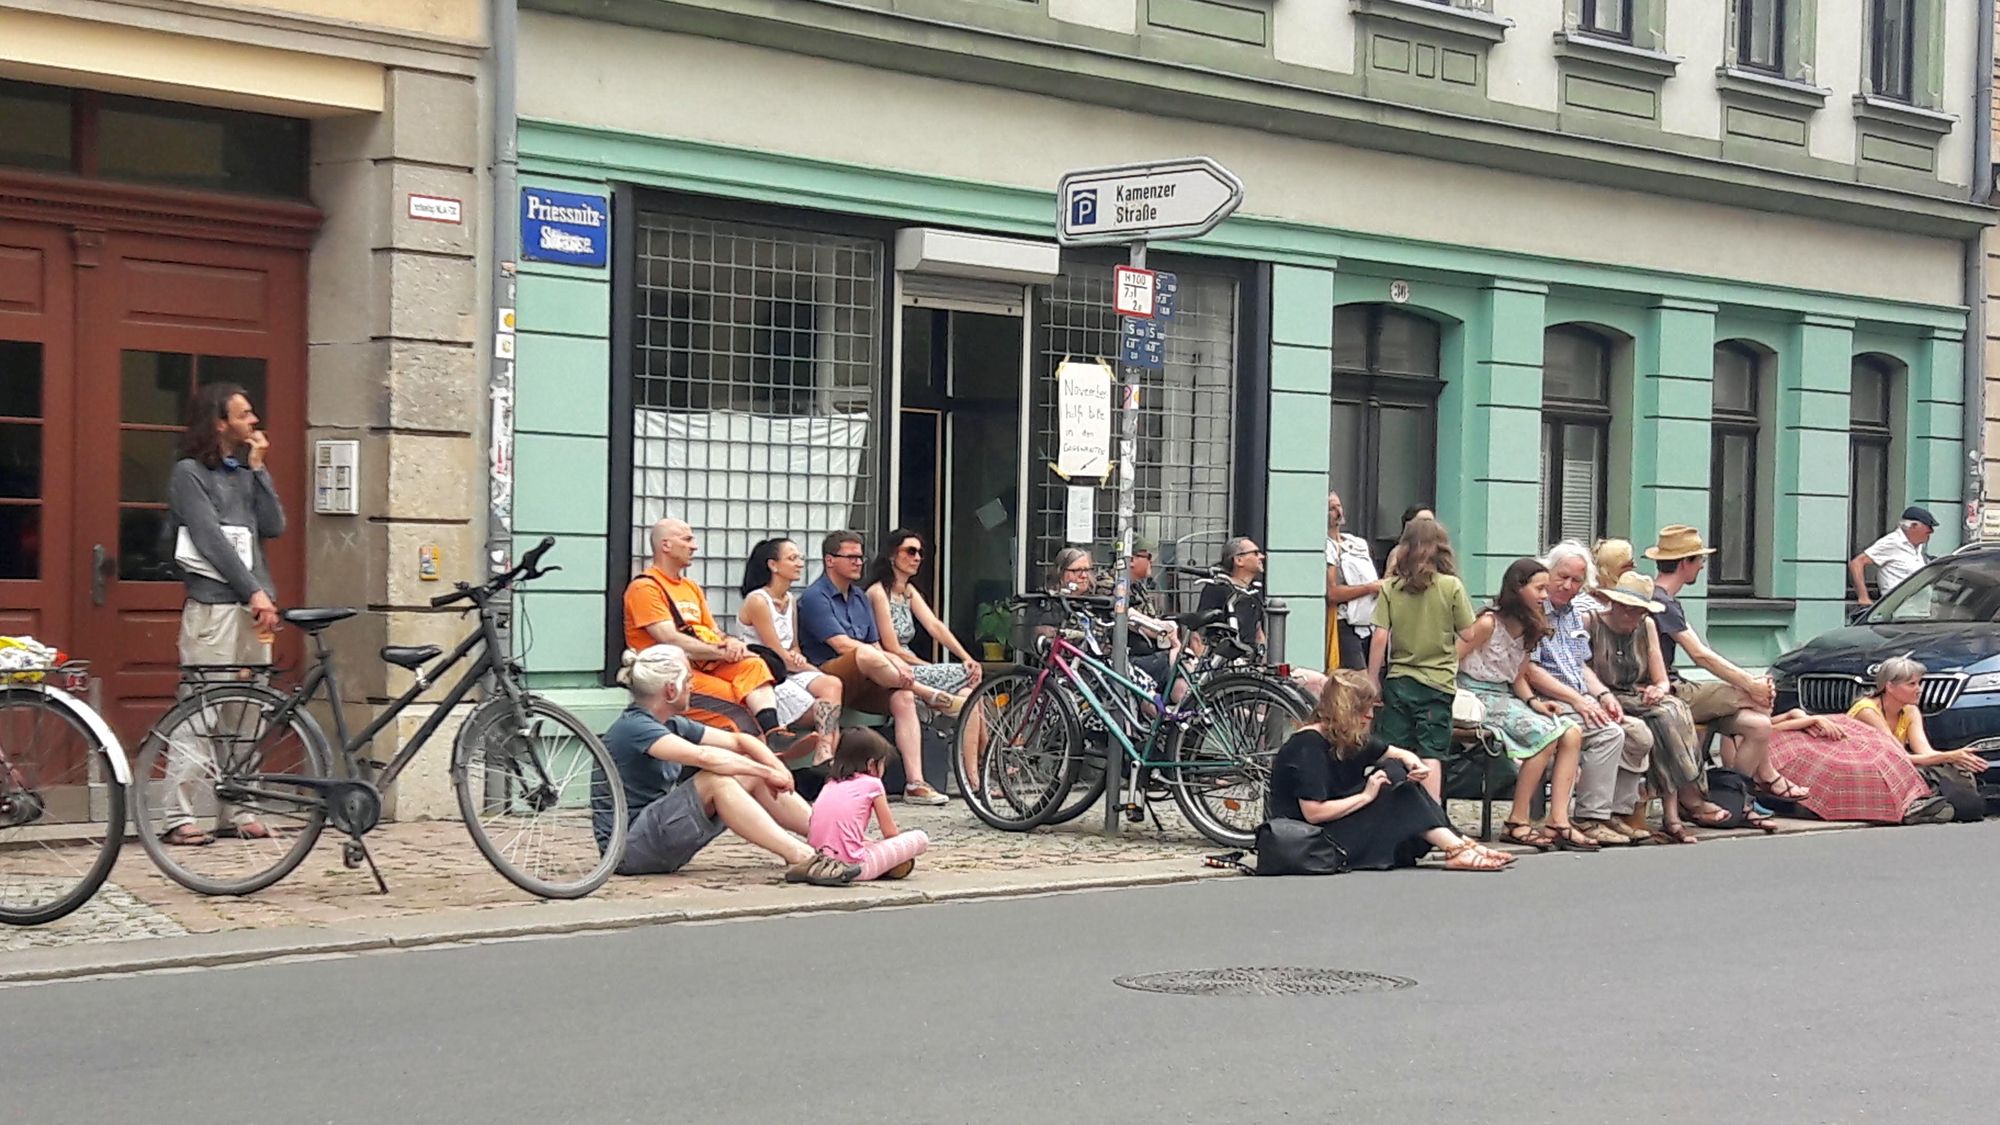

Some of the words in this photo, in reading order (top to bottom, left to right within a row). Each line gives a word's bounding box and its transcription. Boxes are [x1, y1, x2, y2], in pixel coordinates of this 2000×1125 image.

[1116, 184, 1176, 202] Kamenzer
[527, 195, 605, 227] Priessnitz-
[1116, 204, 1157, 223] Straße
